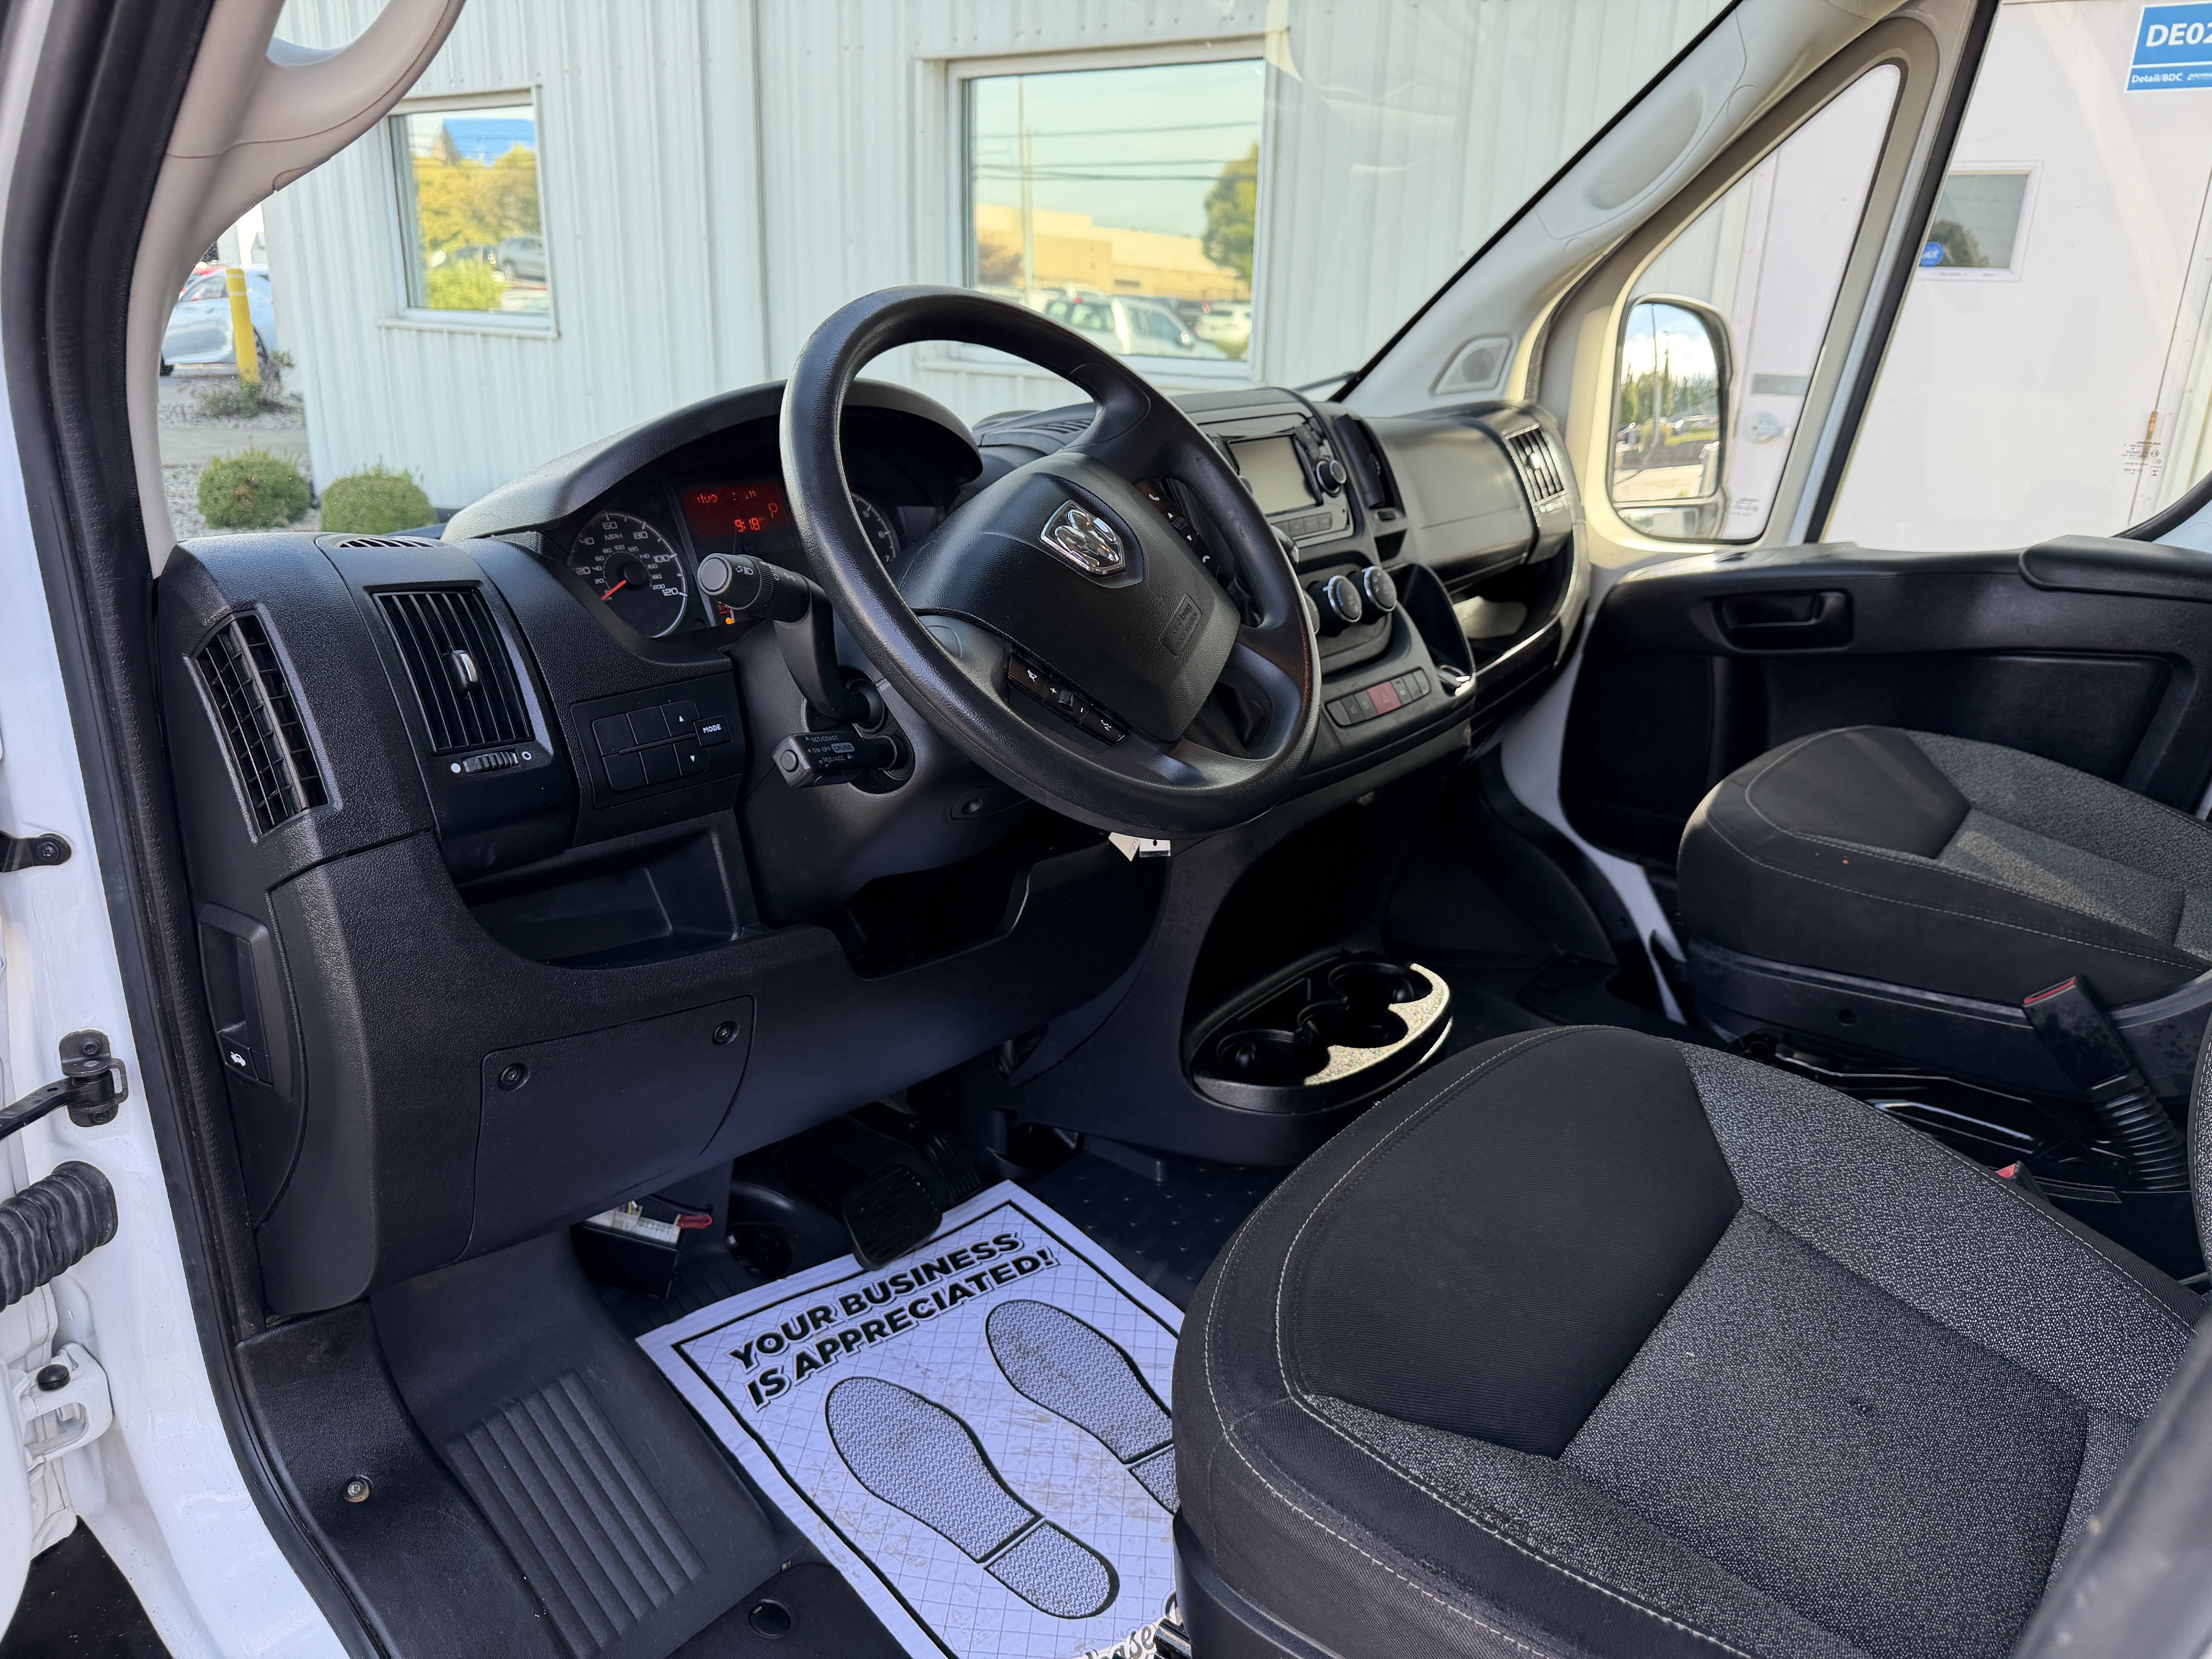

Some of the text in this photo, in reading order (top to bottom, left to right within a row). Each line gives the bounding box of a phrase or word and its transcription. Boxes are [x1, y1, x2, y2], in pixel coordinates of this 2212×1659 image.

[2131, 73, 2183, 83] Detail/BDC
[768, 502, 778, 519] P
[603, 521, 618, 530] 60
[734, 518, 761, 533] 9:18
[633, 531, 648, 539] 80
[580, 537, 595, 545] 40
[653, 554, 670, 563] 100
[576, 567, 591, 575] 20
[662, 587, 679, 596] 120
[702, 724, 722, 733] MODE
[728, 1232, 1021, 1371] YOUR BUSINESS
[747, 1248, 1055, 1408] IS APPRECIATED!
